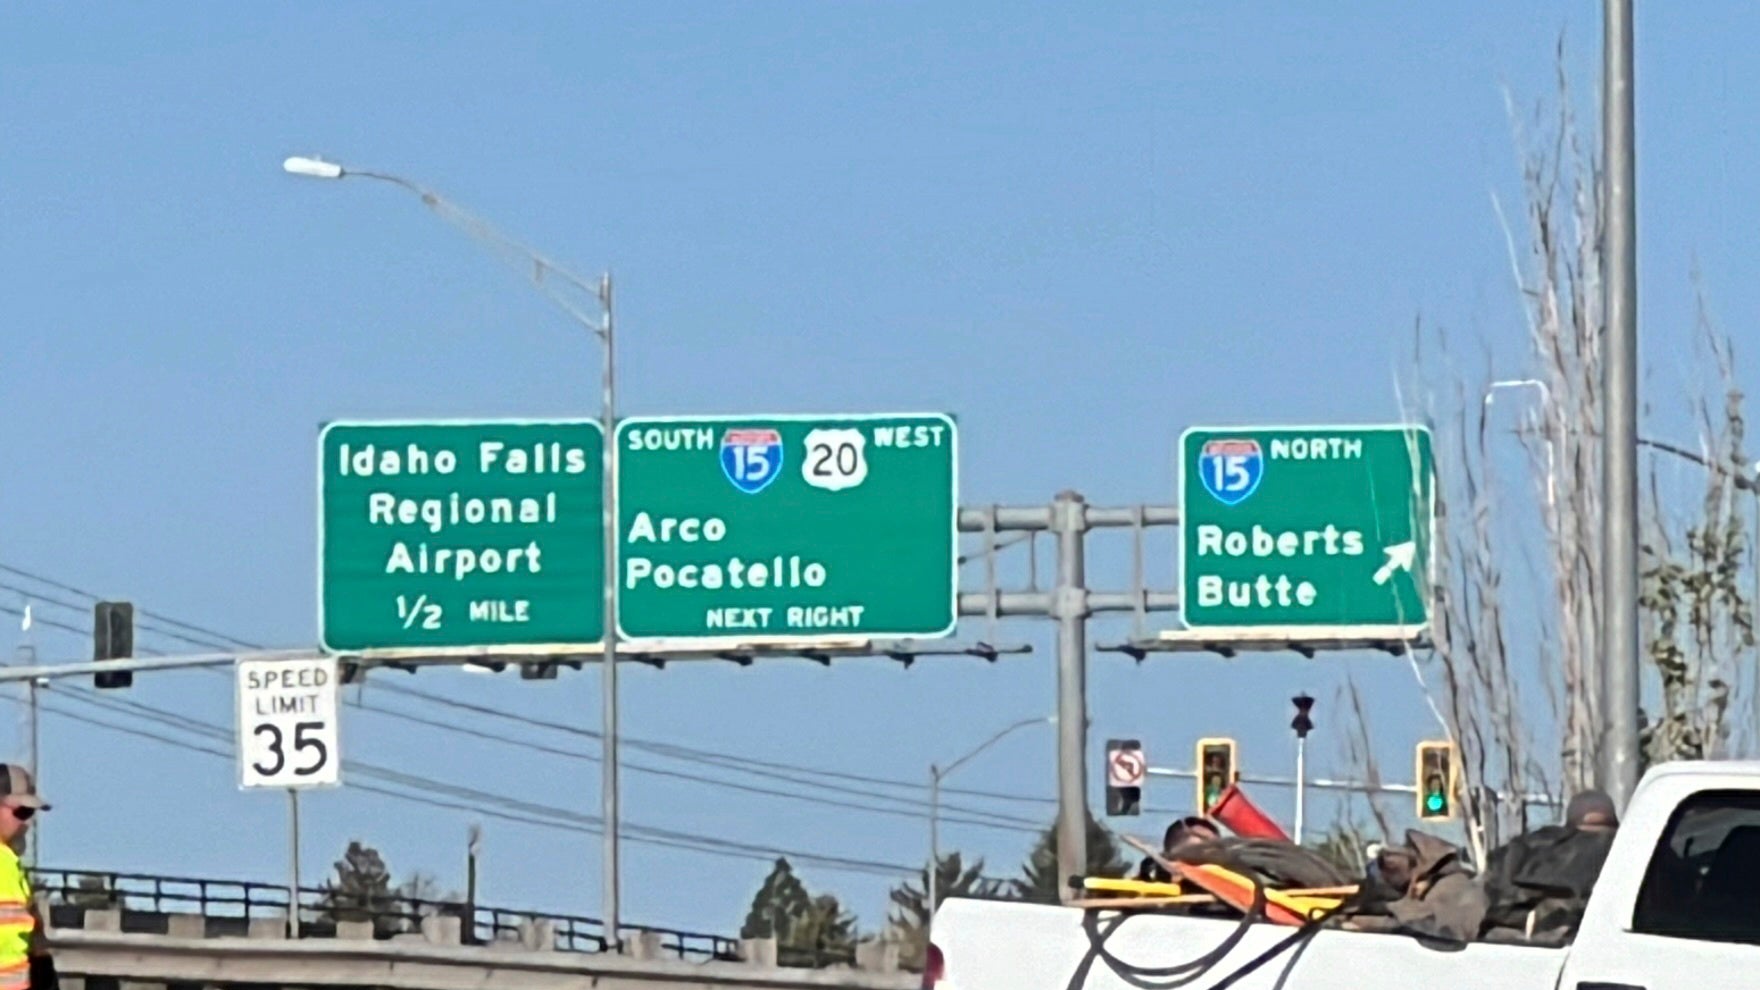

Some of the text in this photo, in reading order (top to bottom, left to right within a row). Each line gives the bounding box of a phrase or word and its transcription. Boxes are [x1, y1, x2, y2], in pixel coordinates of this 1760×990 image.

[340, 441, 586, 476] Idaho Falls
[628, 428, 714, 450] SOUTH
[733, 446, 770, 481] 15
[812, 442, 858, 477] 20
[874, 426, 944, 447] WEST
[1270, 438, 1362, 460] NORTH
[1213, 456, 1250, 491] 15
[369, 491, 556, 534] Regional
[627, 511, 727, 543] Arco
[1197, 524, 1364, 557] Roberts
[385, 540, 542, 581] Airport
[626, 555, 827, 590] Pocatello
[1197, 574, 1318, 608] Butte
[469, 600, 531, 623] MILE
[706, 605, 865, 629] NEXT RIGHT
[248, 667, 328, 689] SPEED
[255, 694, 319, 715] LIMIT
[252, 722, 327, 776] 35
